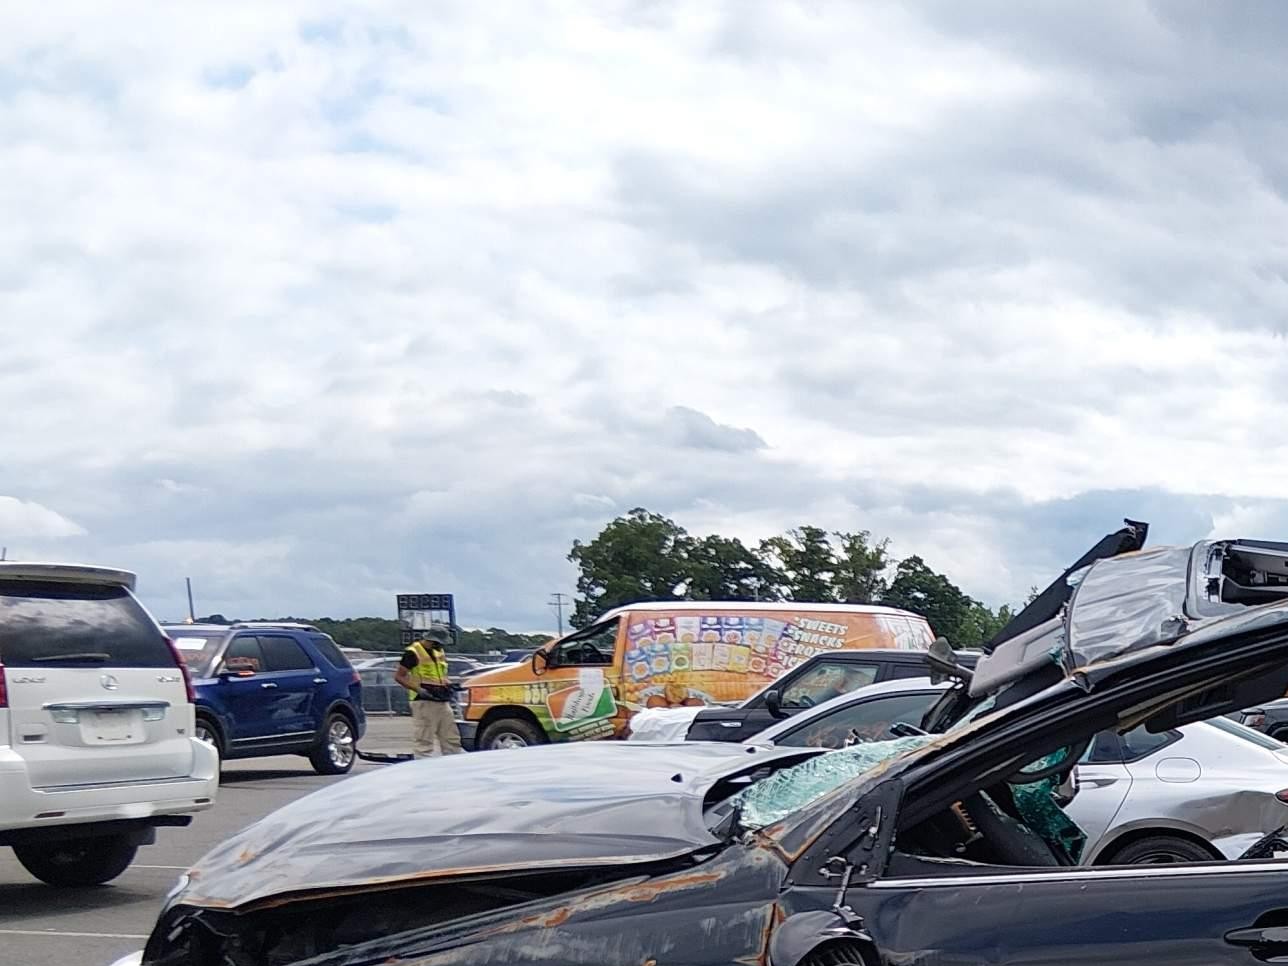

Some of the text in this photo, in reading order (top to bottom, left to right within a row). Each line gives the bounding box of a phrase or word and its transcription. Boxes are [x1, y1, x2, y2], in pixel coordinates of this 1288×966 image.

[800, 617, 848, 635] SWEETS
[792, 630, 846, 648] SNACKS
[788, 643, 823, 657] FROZ
